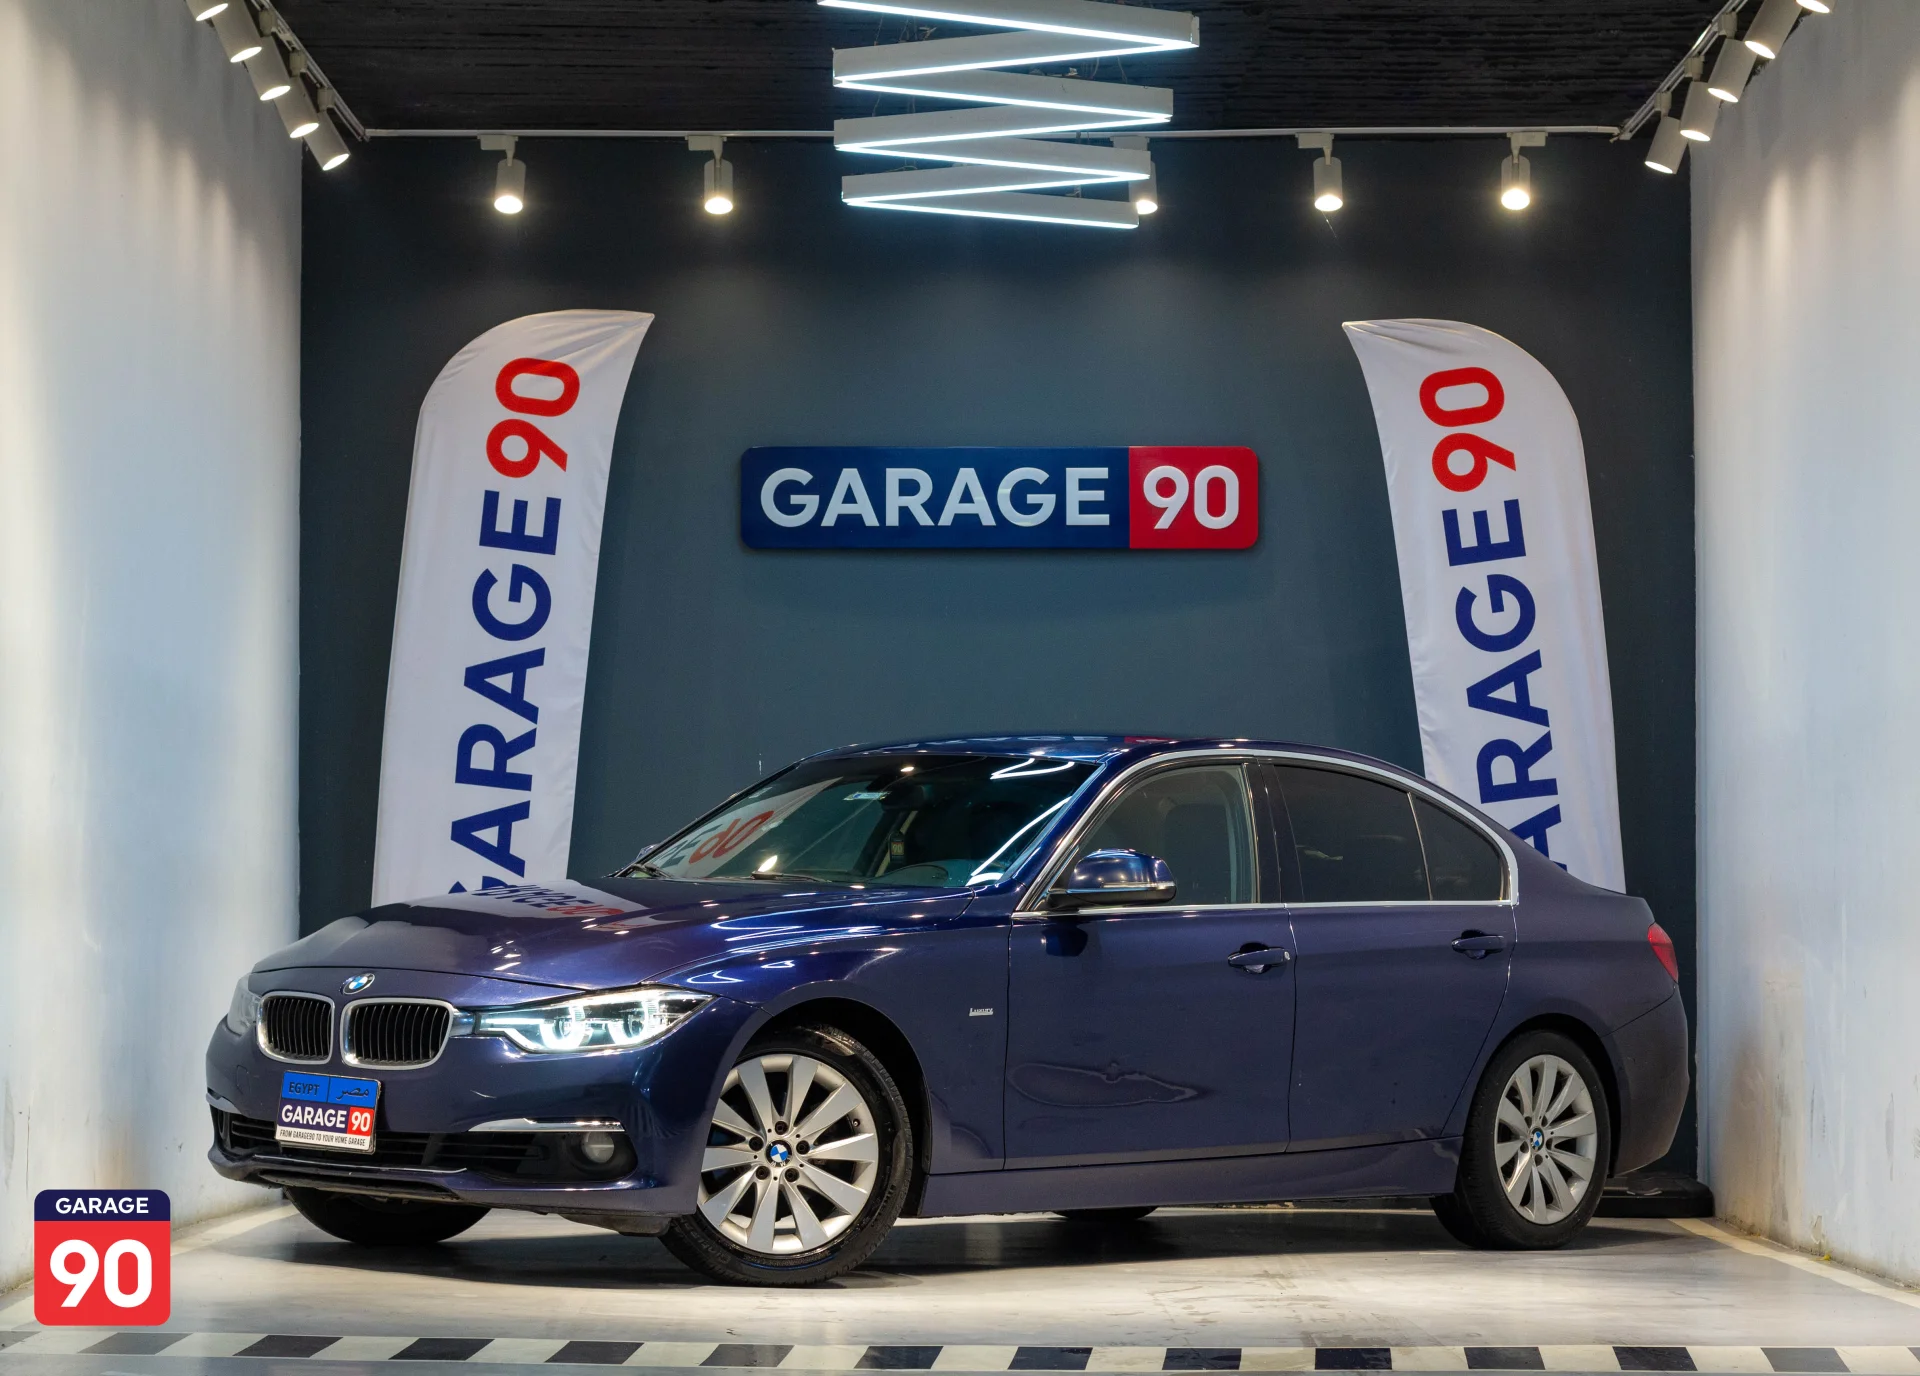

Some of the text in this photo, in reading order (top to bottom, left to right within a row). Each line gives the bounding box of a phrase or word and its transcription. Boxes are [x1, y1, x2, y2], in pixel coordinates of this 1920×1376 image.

[760, 465, 1240, 530] GARAGE 90
[289, 1081, 320, 1095] EGYPT
[336, 1087, 370, 1100] مصر
[281, 1105, 371, 1132] GARAGE 90
[280, 1129, 292, 1137] FROM
[323, 1134, 335, 1142] YOUR
[335, 1136, 348, 1144] HOME
[348, 1137, 366, 1146] GARAGE
